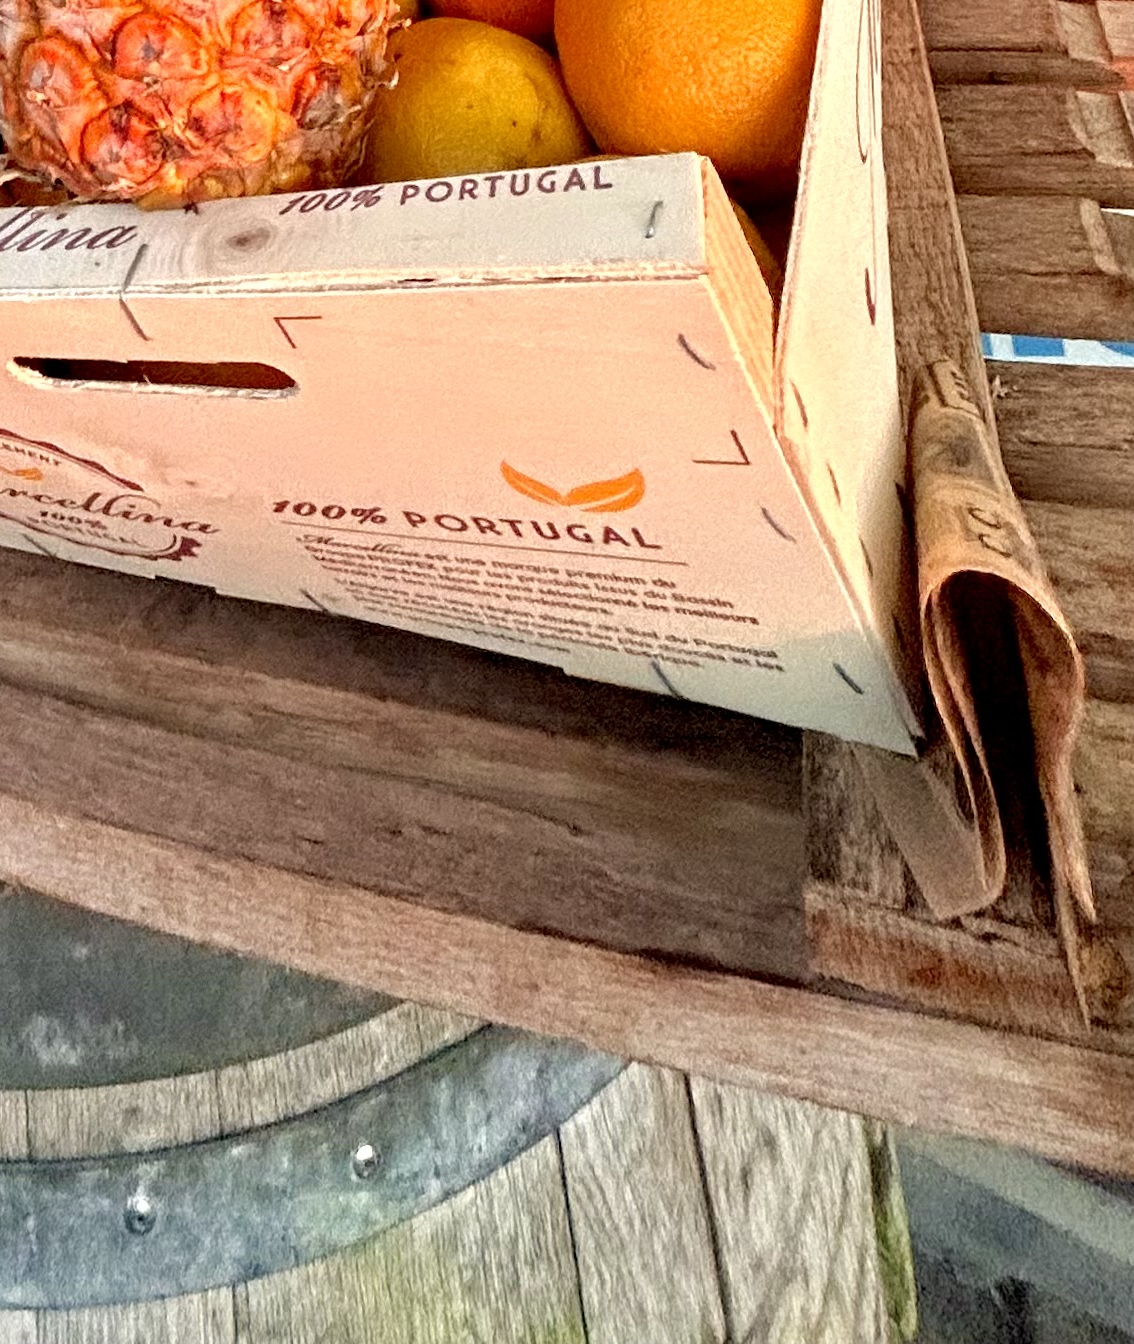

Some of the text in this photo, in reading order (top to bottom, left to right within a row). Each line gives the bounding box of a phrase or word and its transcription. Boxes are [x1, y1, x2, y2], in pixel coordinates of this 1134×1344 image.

[278, 165, 613, 216] 100% PORTUGAL
[38, 510, 109, 530] 100%
[271, 500, 663, 551] 100% PORTUGAL
[492, 560, 559, 576] marque
[565, 568, 647, 587] premium
[652, 576, 676, 589] du
[674, 606, 759, 625] meilleurs
